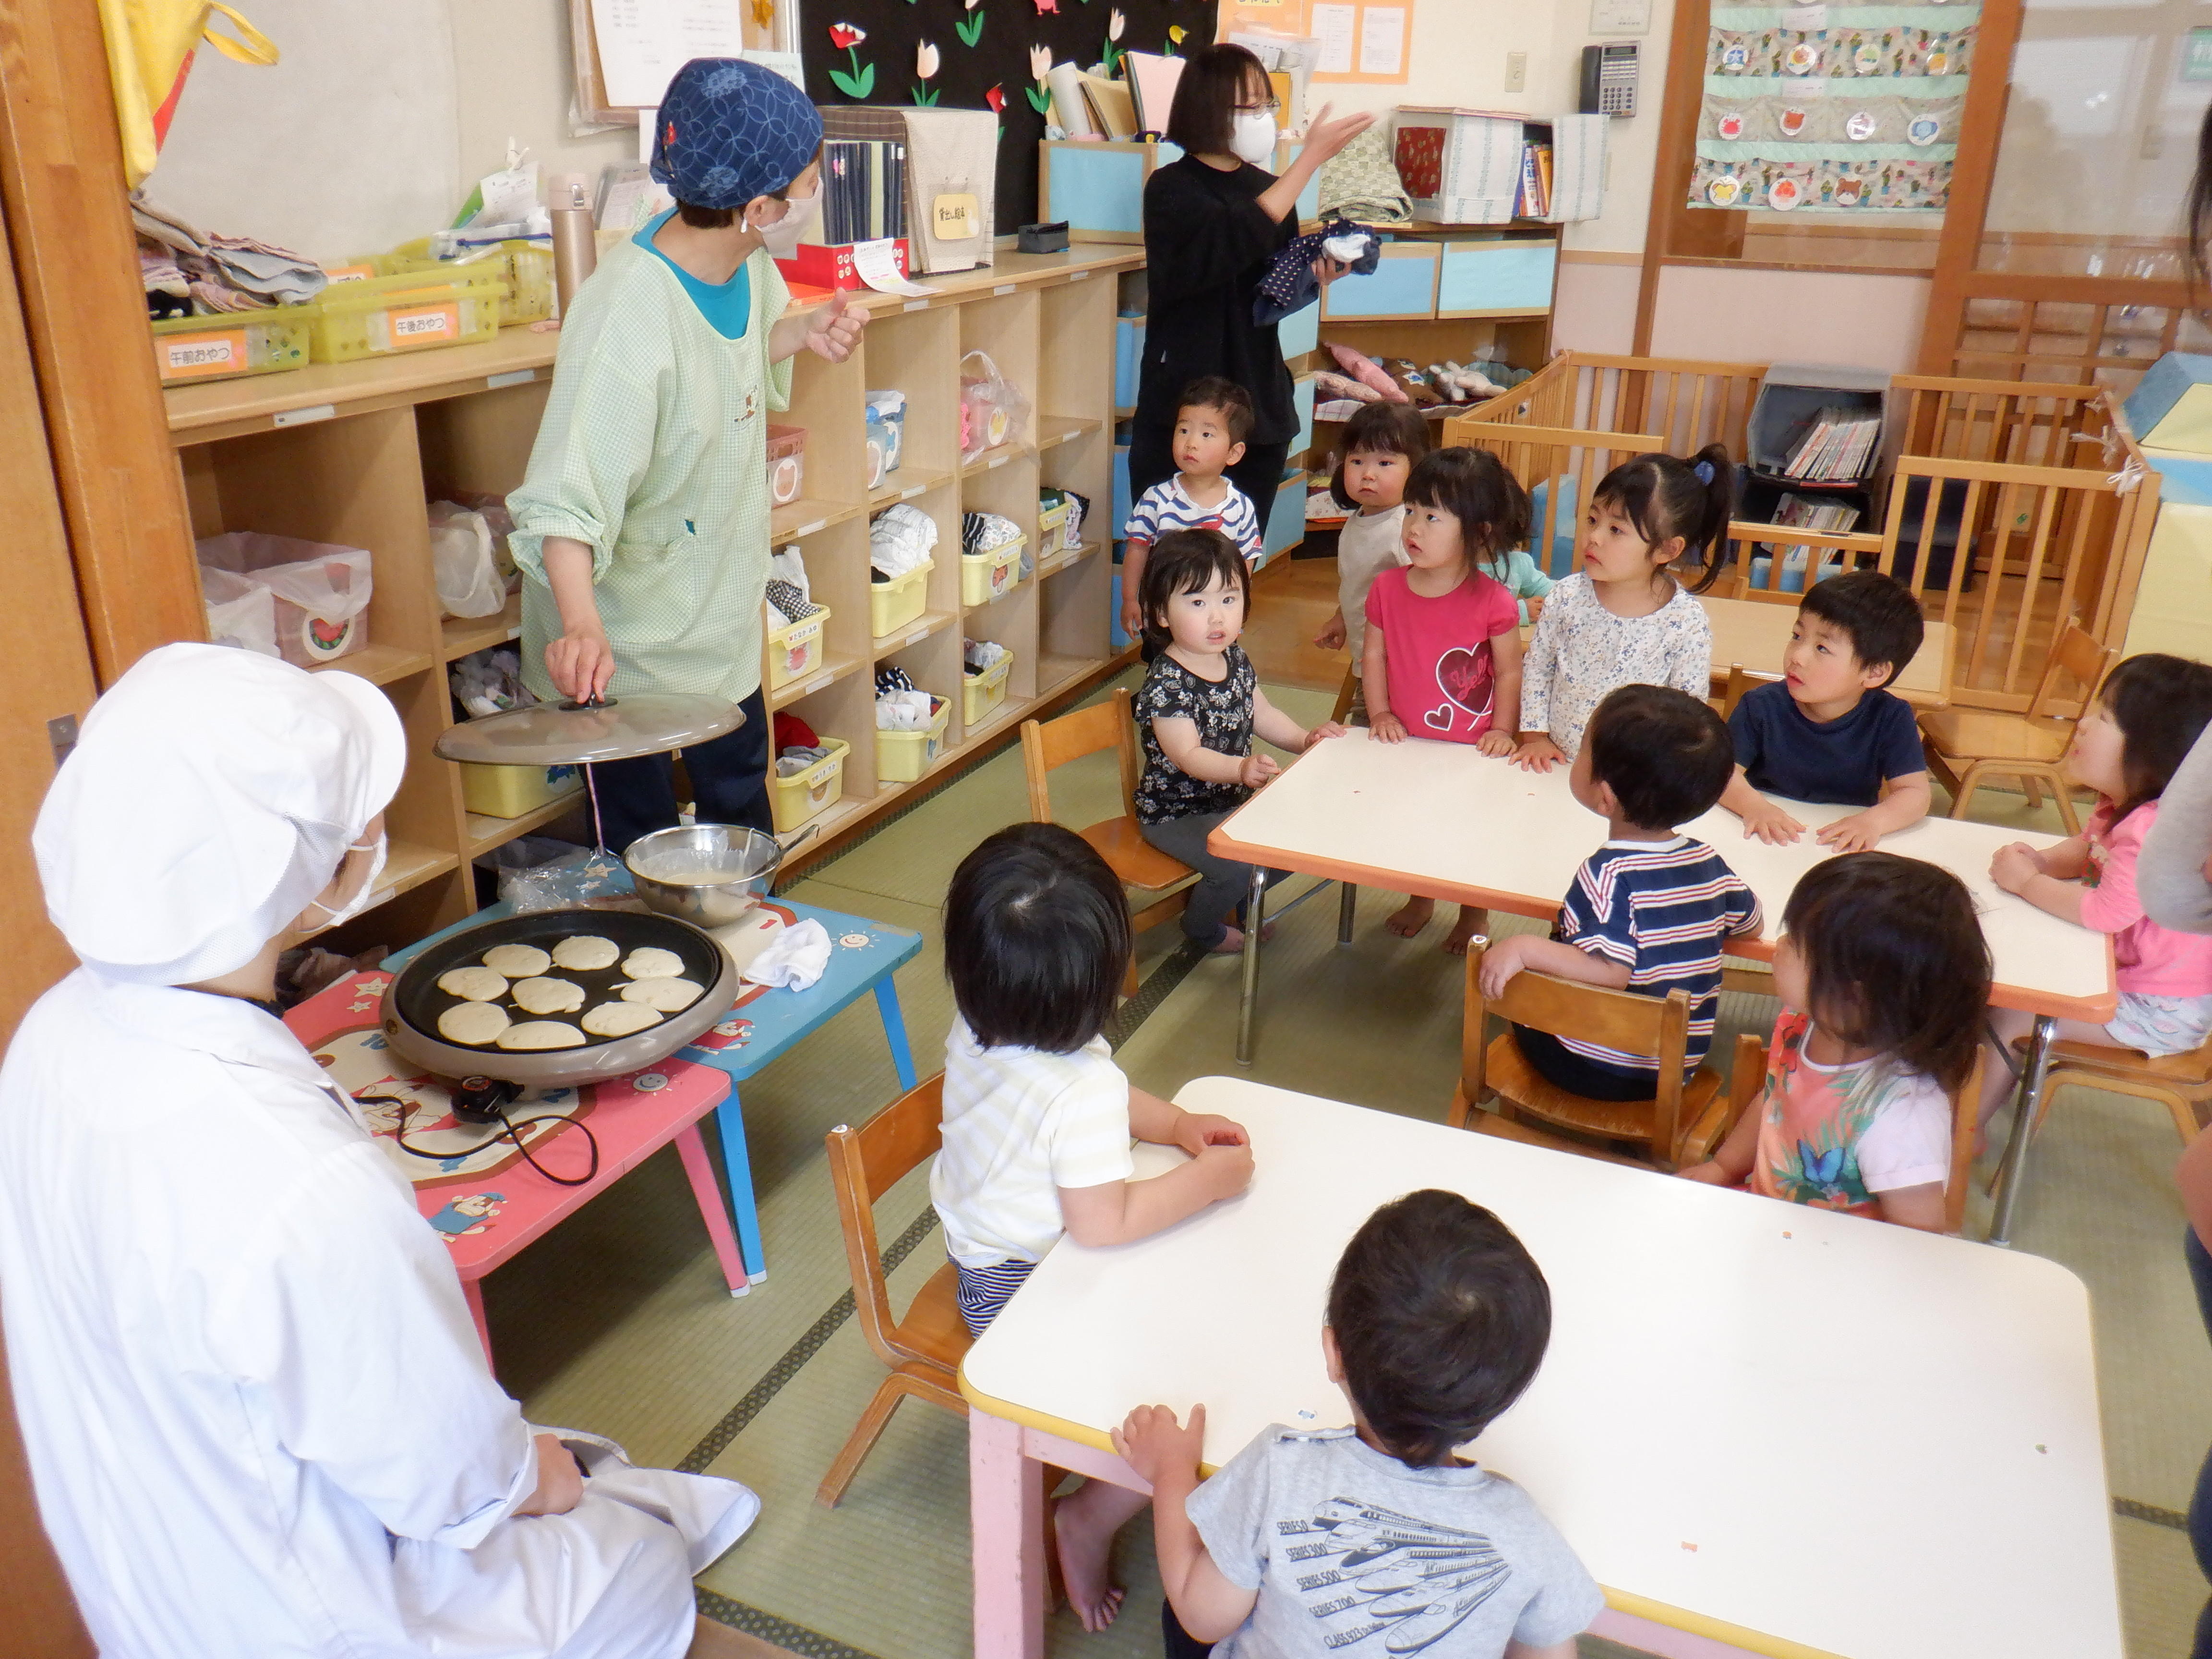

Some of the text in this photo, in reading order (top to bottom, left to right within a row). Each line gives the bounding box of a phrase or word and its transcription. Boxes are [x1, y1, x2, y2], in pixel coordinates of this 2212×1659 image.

[397, 317, 445, 332] 午後おやつ
[170, 347, 229, 365] 午前おやつ
[1276, 1520, 1303, 1534] SERIES
[1286, 1542, 1328, 1561] SERIES 300
[1296, 1569, 1341, 1590] SERIES 500
[1308, 1595, 1356, 1617] SERIES 700
[1323, 1630, 1349, 1648] CLASS
[1346, 1627, 1364, 1643] 923
